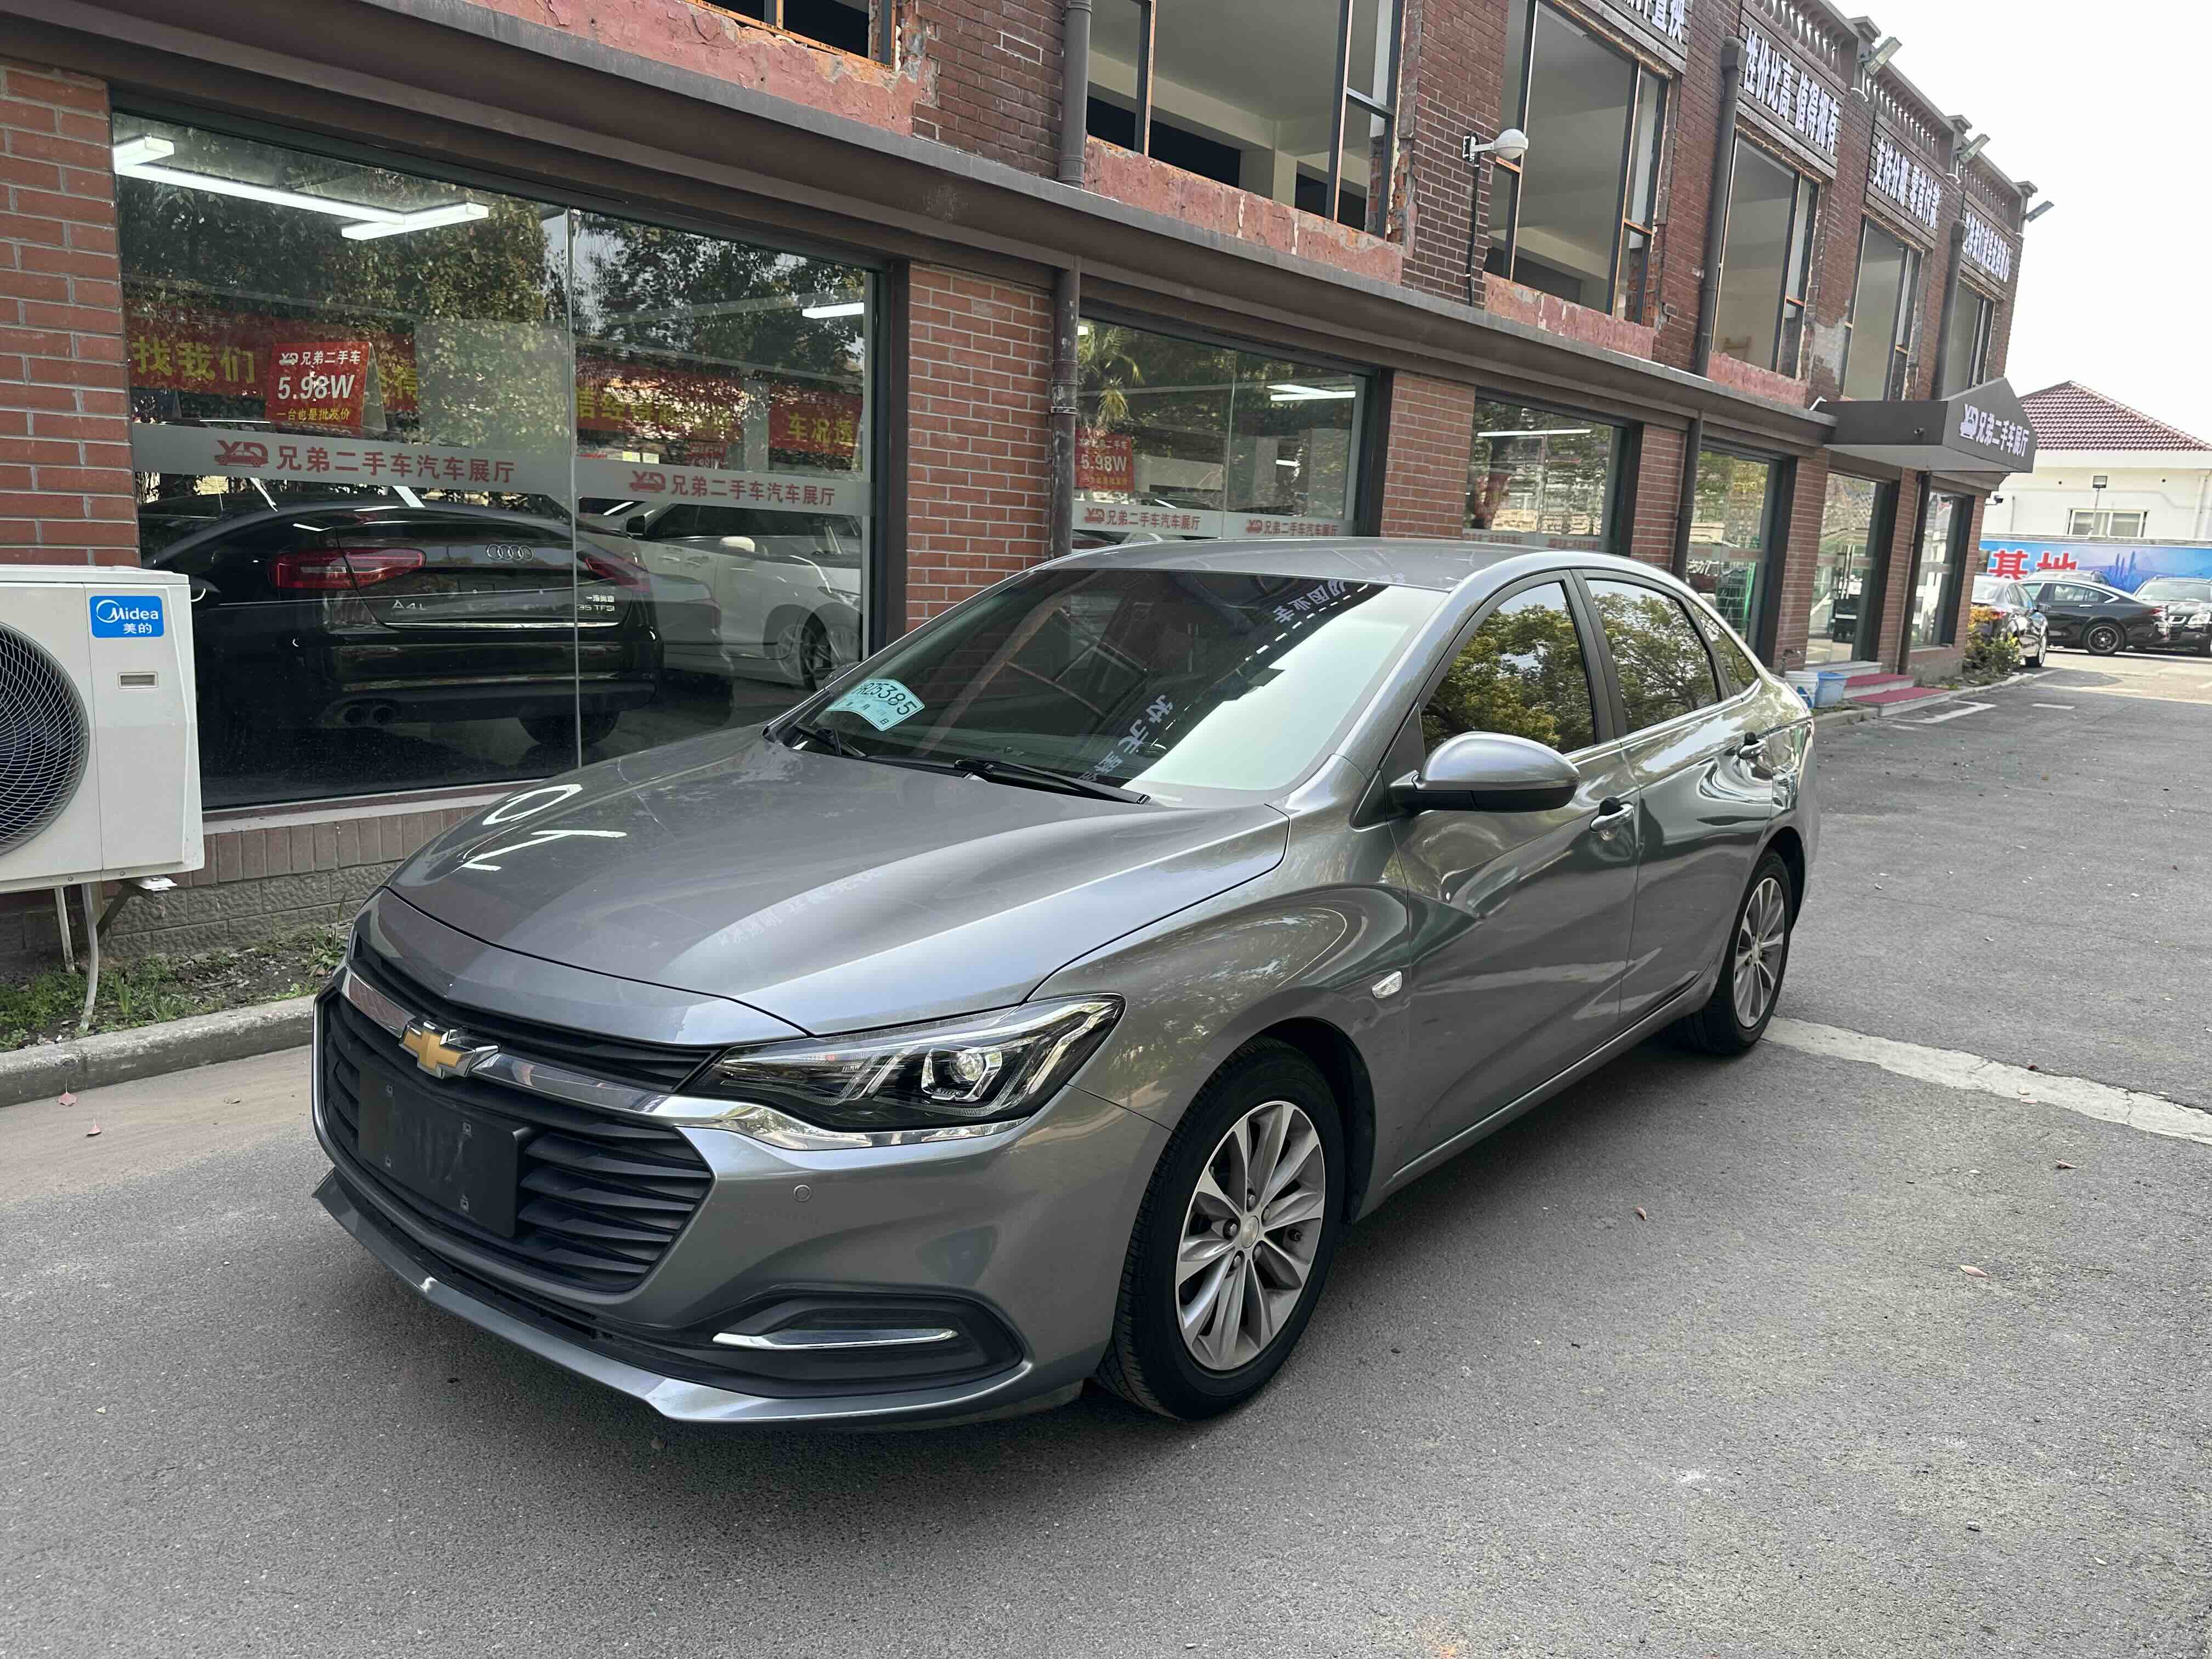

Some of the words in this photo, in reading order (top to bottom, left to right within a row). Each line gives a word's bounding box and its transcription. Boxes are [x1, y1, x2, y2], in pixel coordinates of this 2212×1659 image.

[1743, 27, 1793, 121] 性价比高
[1795, 71, 1839, 156] 值得拥有
[1873, 137, 1910, 207] 支持分期
[132, 335, 256, 383] 找我们
[301, 350, 361, 365] 兄弟二手车
[278, 374, 355, 399] 5.98W
[276, 408, 351, 422] 一台也是批发价
[1976, 411, 2029, 456] 兄弟二手车展厅
[276, 445, 514, 483] 兄弟二手车汽车展厅
[1080, 454, 1127, 472] 5.98W
[671, 475, 836, 506] 兄弟二手车汽车展厅
[1107, 510, 1201, 530] 兄弟二手车汽车展厅
[101, 605, 159, 620] Midea
[122, 623, 153, 634] 美的
